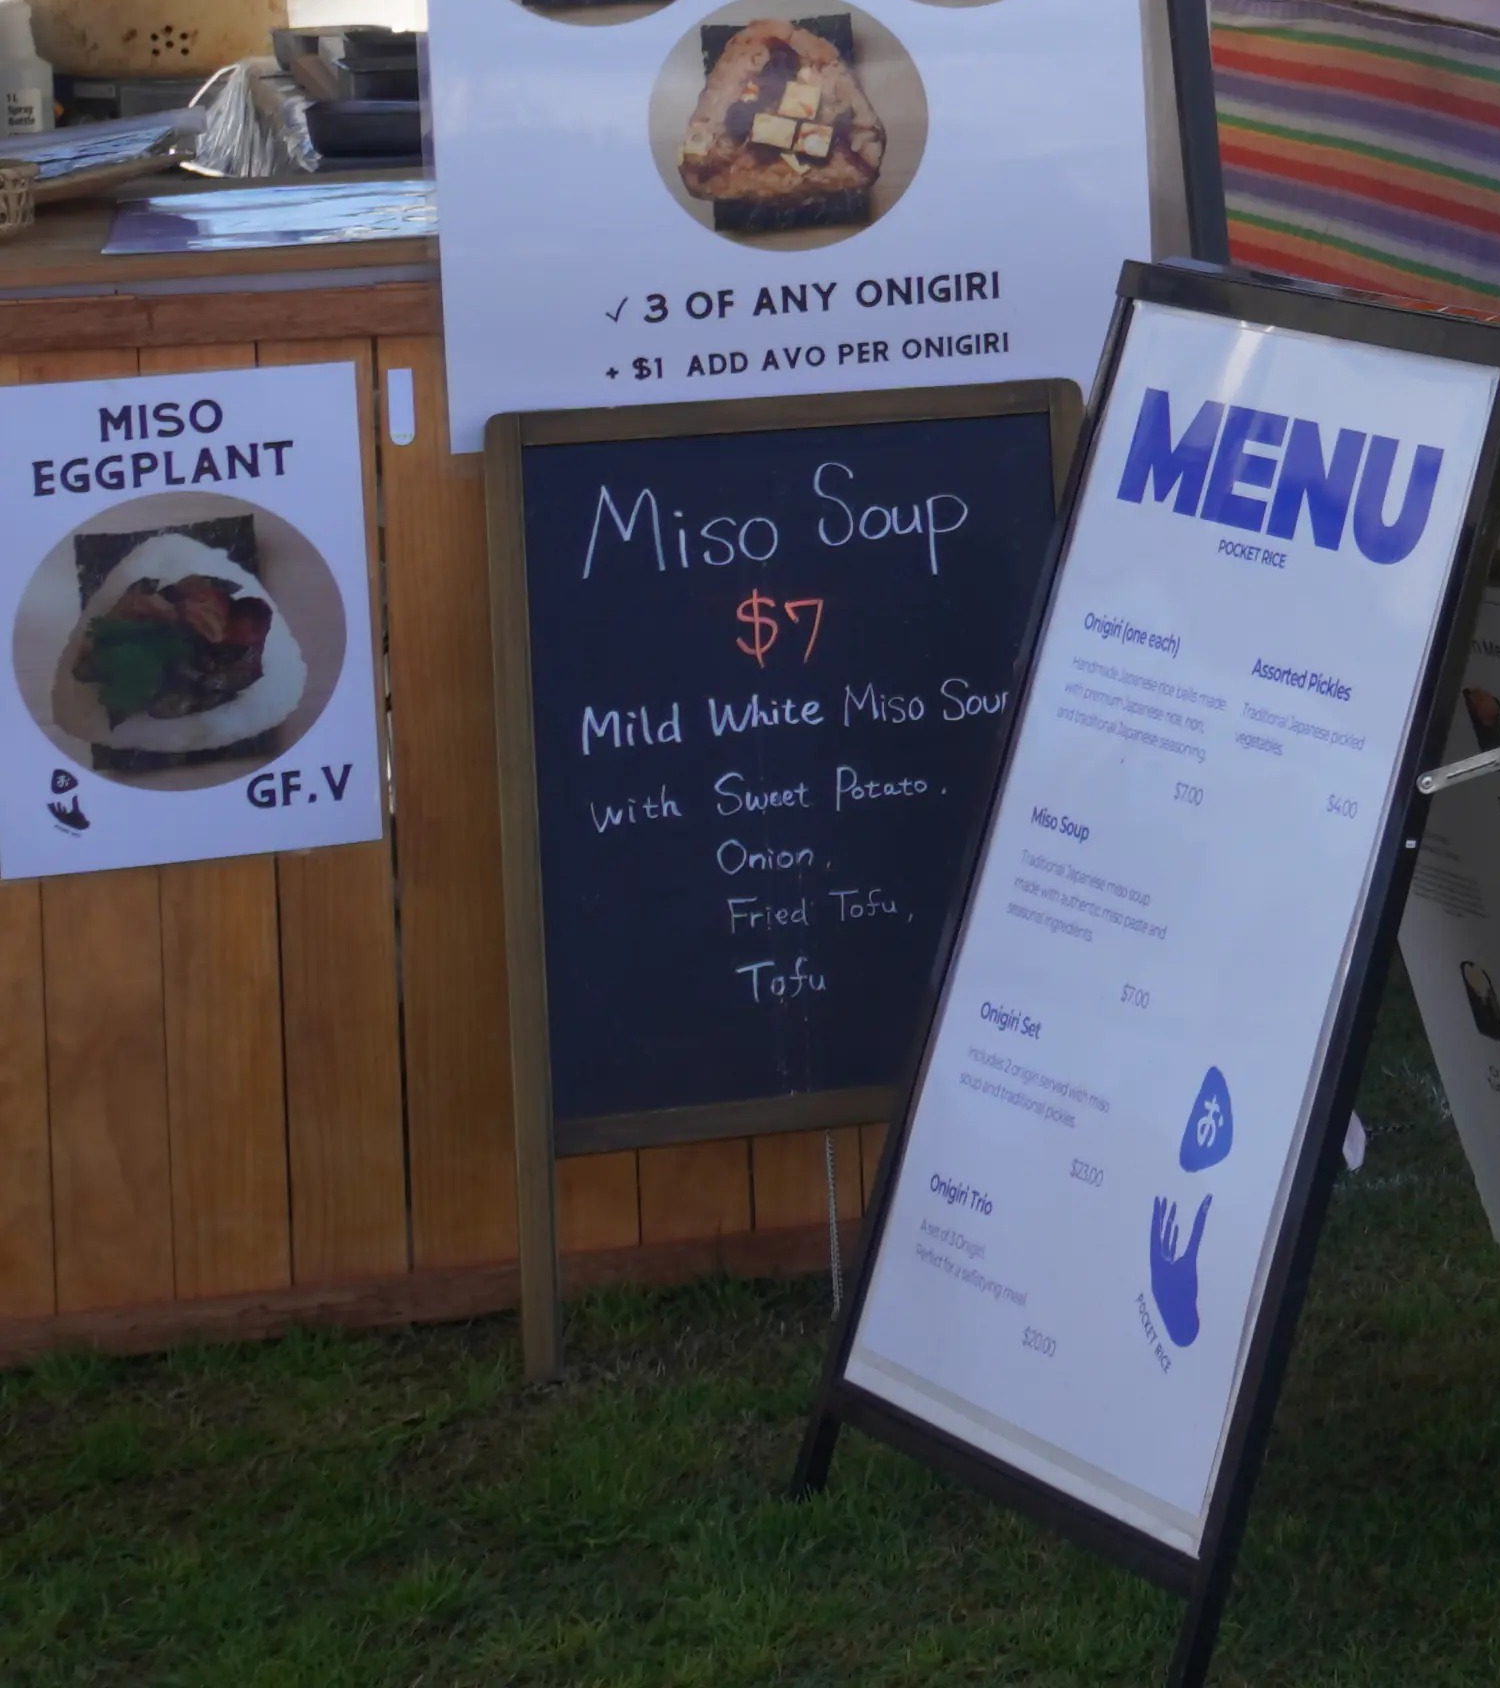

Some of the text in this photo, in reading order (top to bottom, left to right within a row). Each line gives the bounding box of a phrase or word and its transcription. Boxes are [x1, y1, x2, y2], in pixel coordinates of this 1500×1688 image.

[643, 270, 1001, 323] 3 OF ANY ONIGIRI
[632, 331, 1010, 380] $1 ADD AVO PER ONIGIRI
[98, 399, 226, 444] MISO
[31, 440, 294, 497] EGGPLANT
[1116, 387, 1445, 565] MENU
[582, 461, 969, 580] Miso Soup
[1218, 538, 1288, 569] POCKET RICE
[736, 587, 824, 669] $7
[1084, 612, 1181, 659] Onigiri (one each)
[1251, 657, 1353, 702] Assorted Pickles
[582, 682, 926, 755] Mild White Miso
[590, 771, 810, 834] with Sweet
[1173, 781, 1204, 806] $7.00
[1325, 793, 1359, 820] $4.00
[1031, 805, 1090, 844] Miso Soup
[727, 895, 809, 934] Fried
[735, 957, 827, 1003] Tofu
[1120, 983, 1151, 1010] $7.00
[980, 1001, 1042, 1041] Onigiri Set
[930, 1173, 994, 1216] Onigiri Trio
[1069, 1157, 1105, 1188] $23.00
[1022, 1325, 1057, 1358] $20.00
[1134, 1292, 1172, 1375] POCKET RICE
